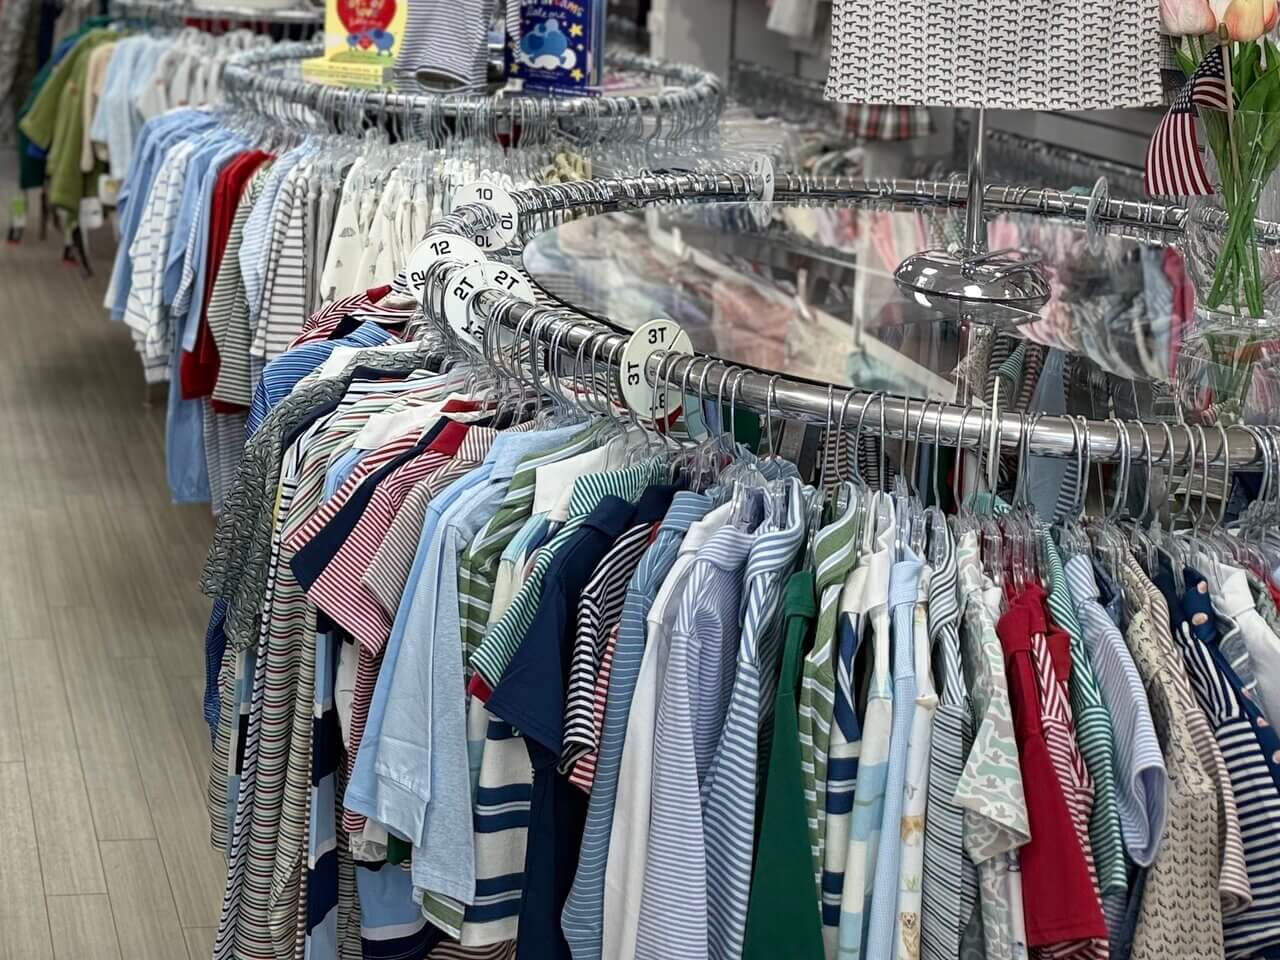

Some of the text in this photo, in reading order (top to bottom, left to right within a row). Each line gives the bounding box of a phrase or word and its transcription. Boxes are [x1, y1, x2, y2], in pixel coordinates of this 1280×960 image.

[475, 188, 493, 201] 10
[501, 212, 513, 230] 10
[430, 240, 451, 256] 12
[475, 234, 493, 248] 10
[411, 270, 425, 291] 12
[453, 276, 474, 301] 2T
[494, 270, 520, 290] 2T
[648, 326, 667, 344] 3T
[627, 361, 640, 386] 3T
